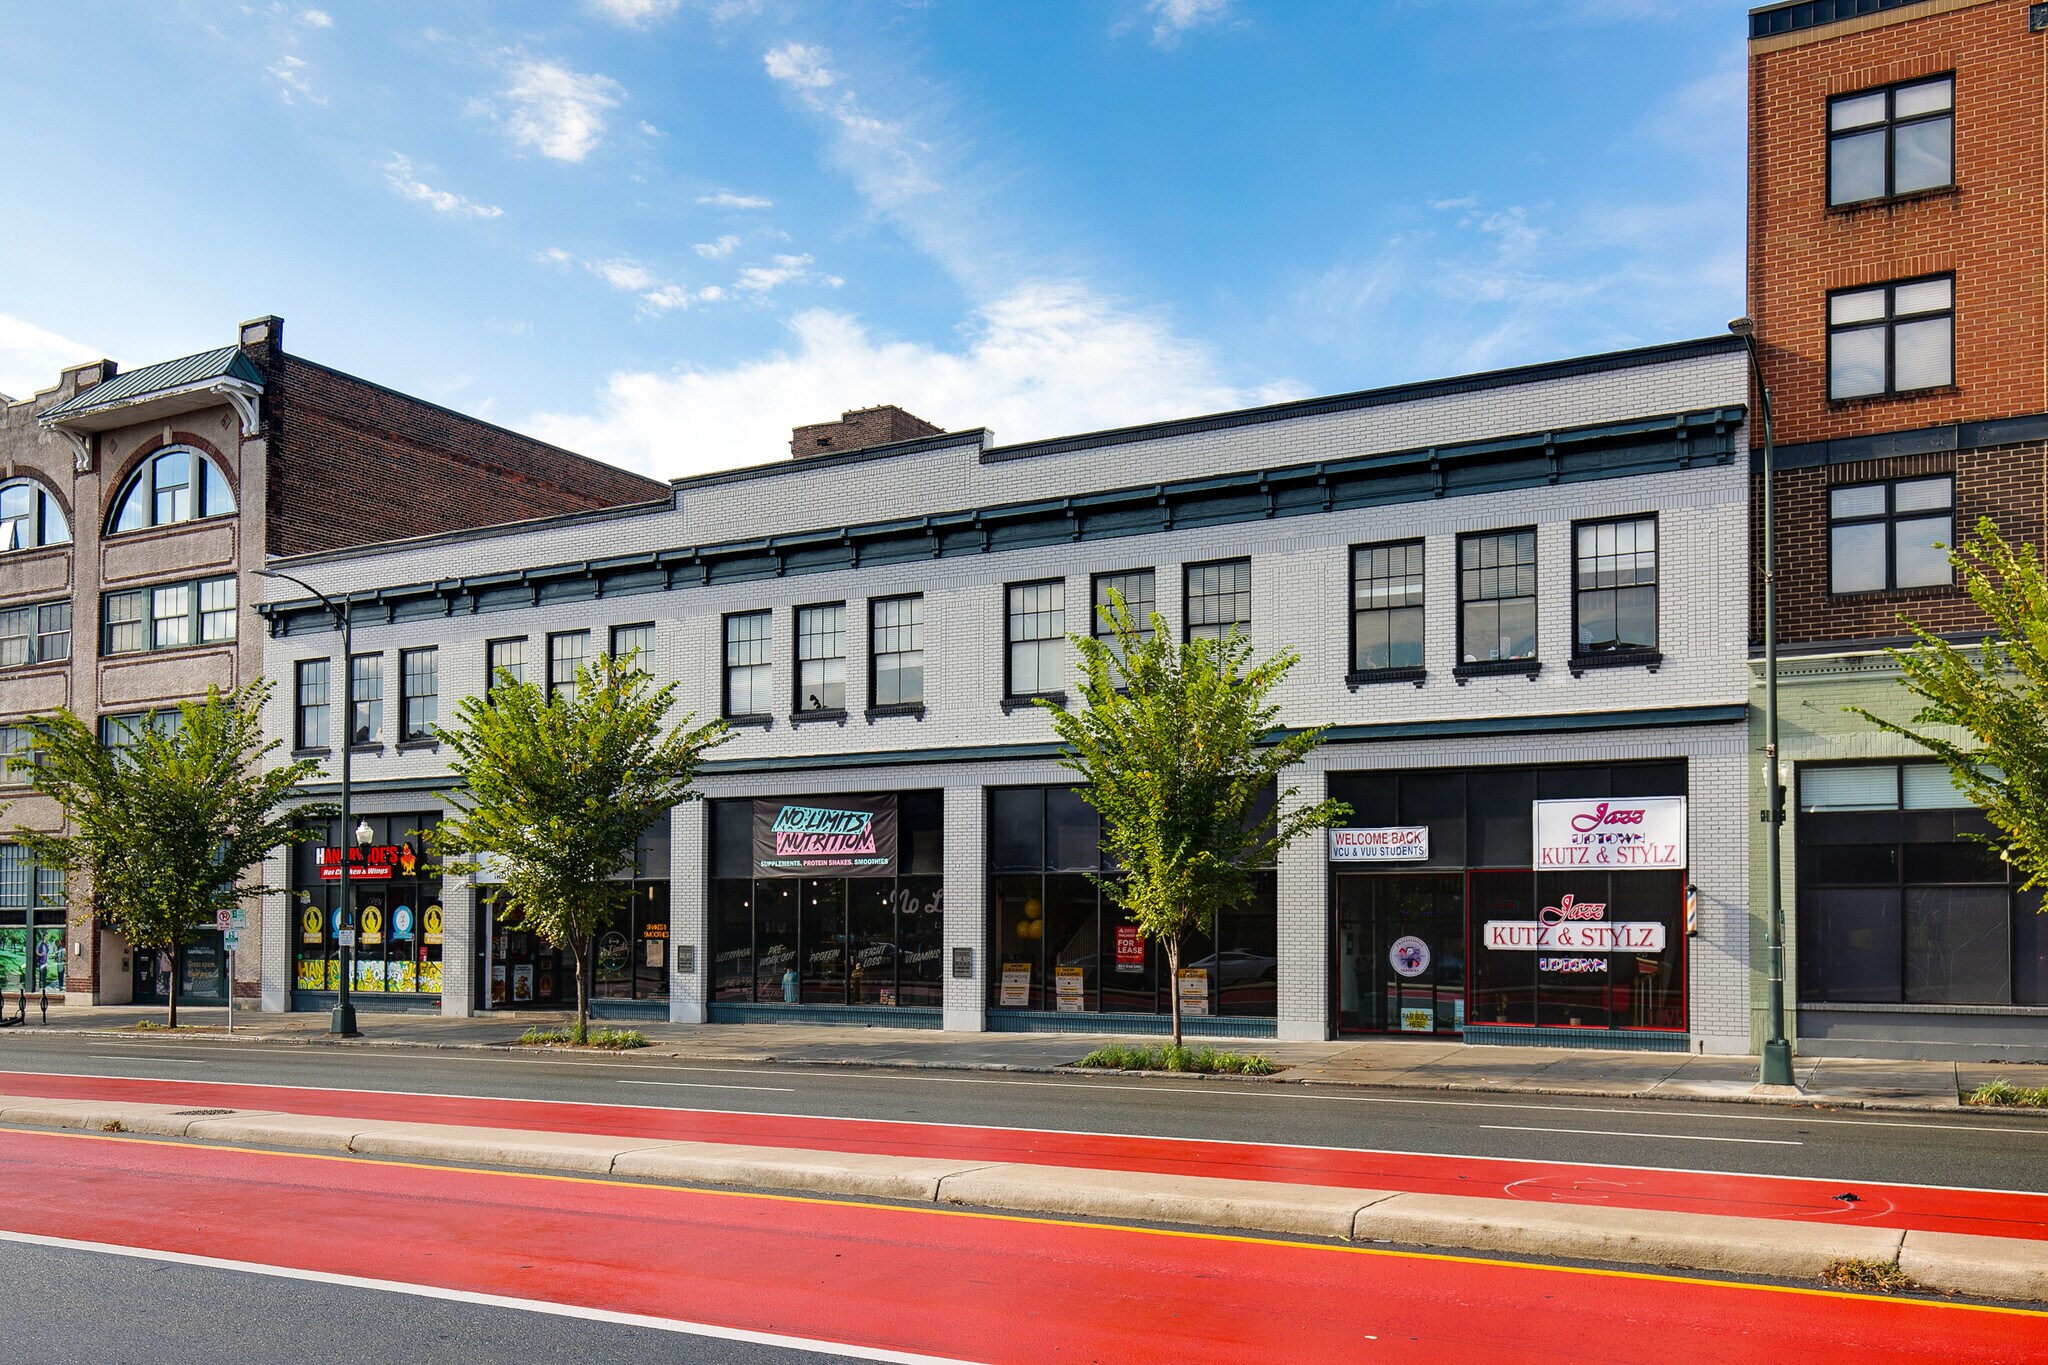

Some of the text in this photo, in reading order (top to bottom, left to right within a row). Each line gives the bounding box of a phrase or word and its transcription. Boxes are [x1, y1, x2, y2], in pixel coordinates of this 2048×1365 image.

[776, 808, 866, 832] NO LIMITS
[1571, 803, 1645, 832] Jazz
[779, 831, 869, 854] NUTRITION
[1335, 832, 1421, 845] WELCOME BACK
[1571, 833, 1646, 845] UPTOWN
[316, 847, 362, 864] HANRY
[1333, 845, 1424, 857] VCU & VUU STUDENTS
[1541, 842, 1677, 865] KUTZ & STYLZ
[803, 859, 827, 867] PROTEIN
[854, 858, 889, 866] SMOOTHIES
[335, 868, 361, 876] Cken
[367, 867, 389, 876] Wings
[889, 889, 919, 914] No
[1540, 894, 1606, 927] Jazz
[1492, 923, 1655, 947] KUTZ & STYLZ
[766, 944, 786, 956] PRE-
[1117, 939, 1135, 947] FOR
[1117, 946, 1143, 954] LEASE
[715, 947, 752, 963] NUTRITION
[809, 949, 841, 962] PROTEIN
[858, 944, 887, 959] WEIGHT
[905, 949, 941, 963] VITAMINS
[863, 956, 883, 968] LOSS
[1539, 957, 1608, 973] UPTOWN
[1402, 1012, 1433, 1021] RAM BUCKS
